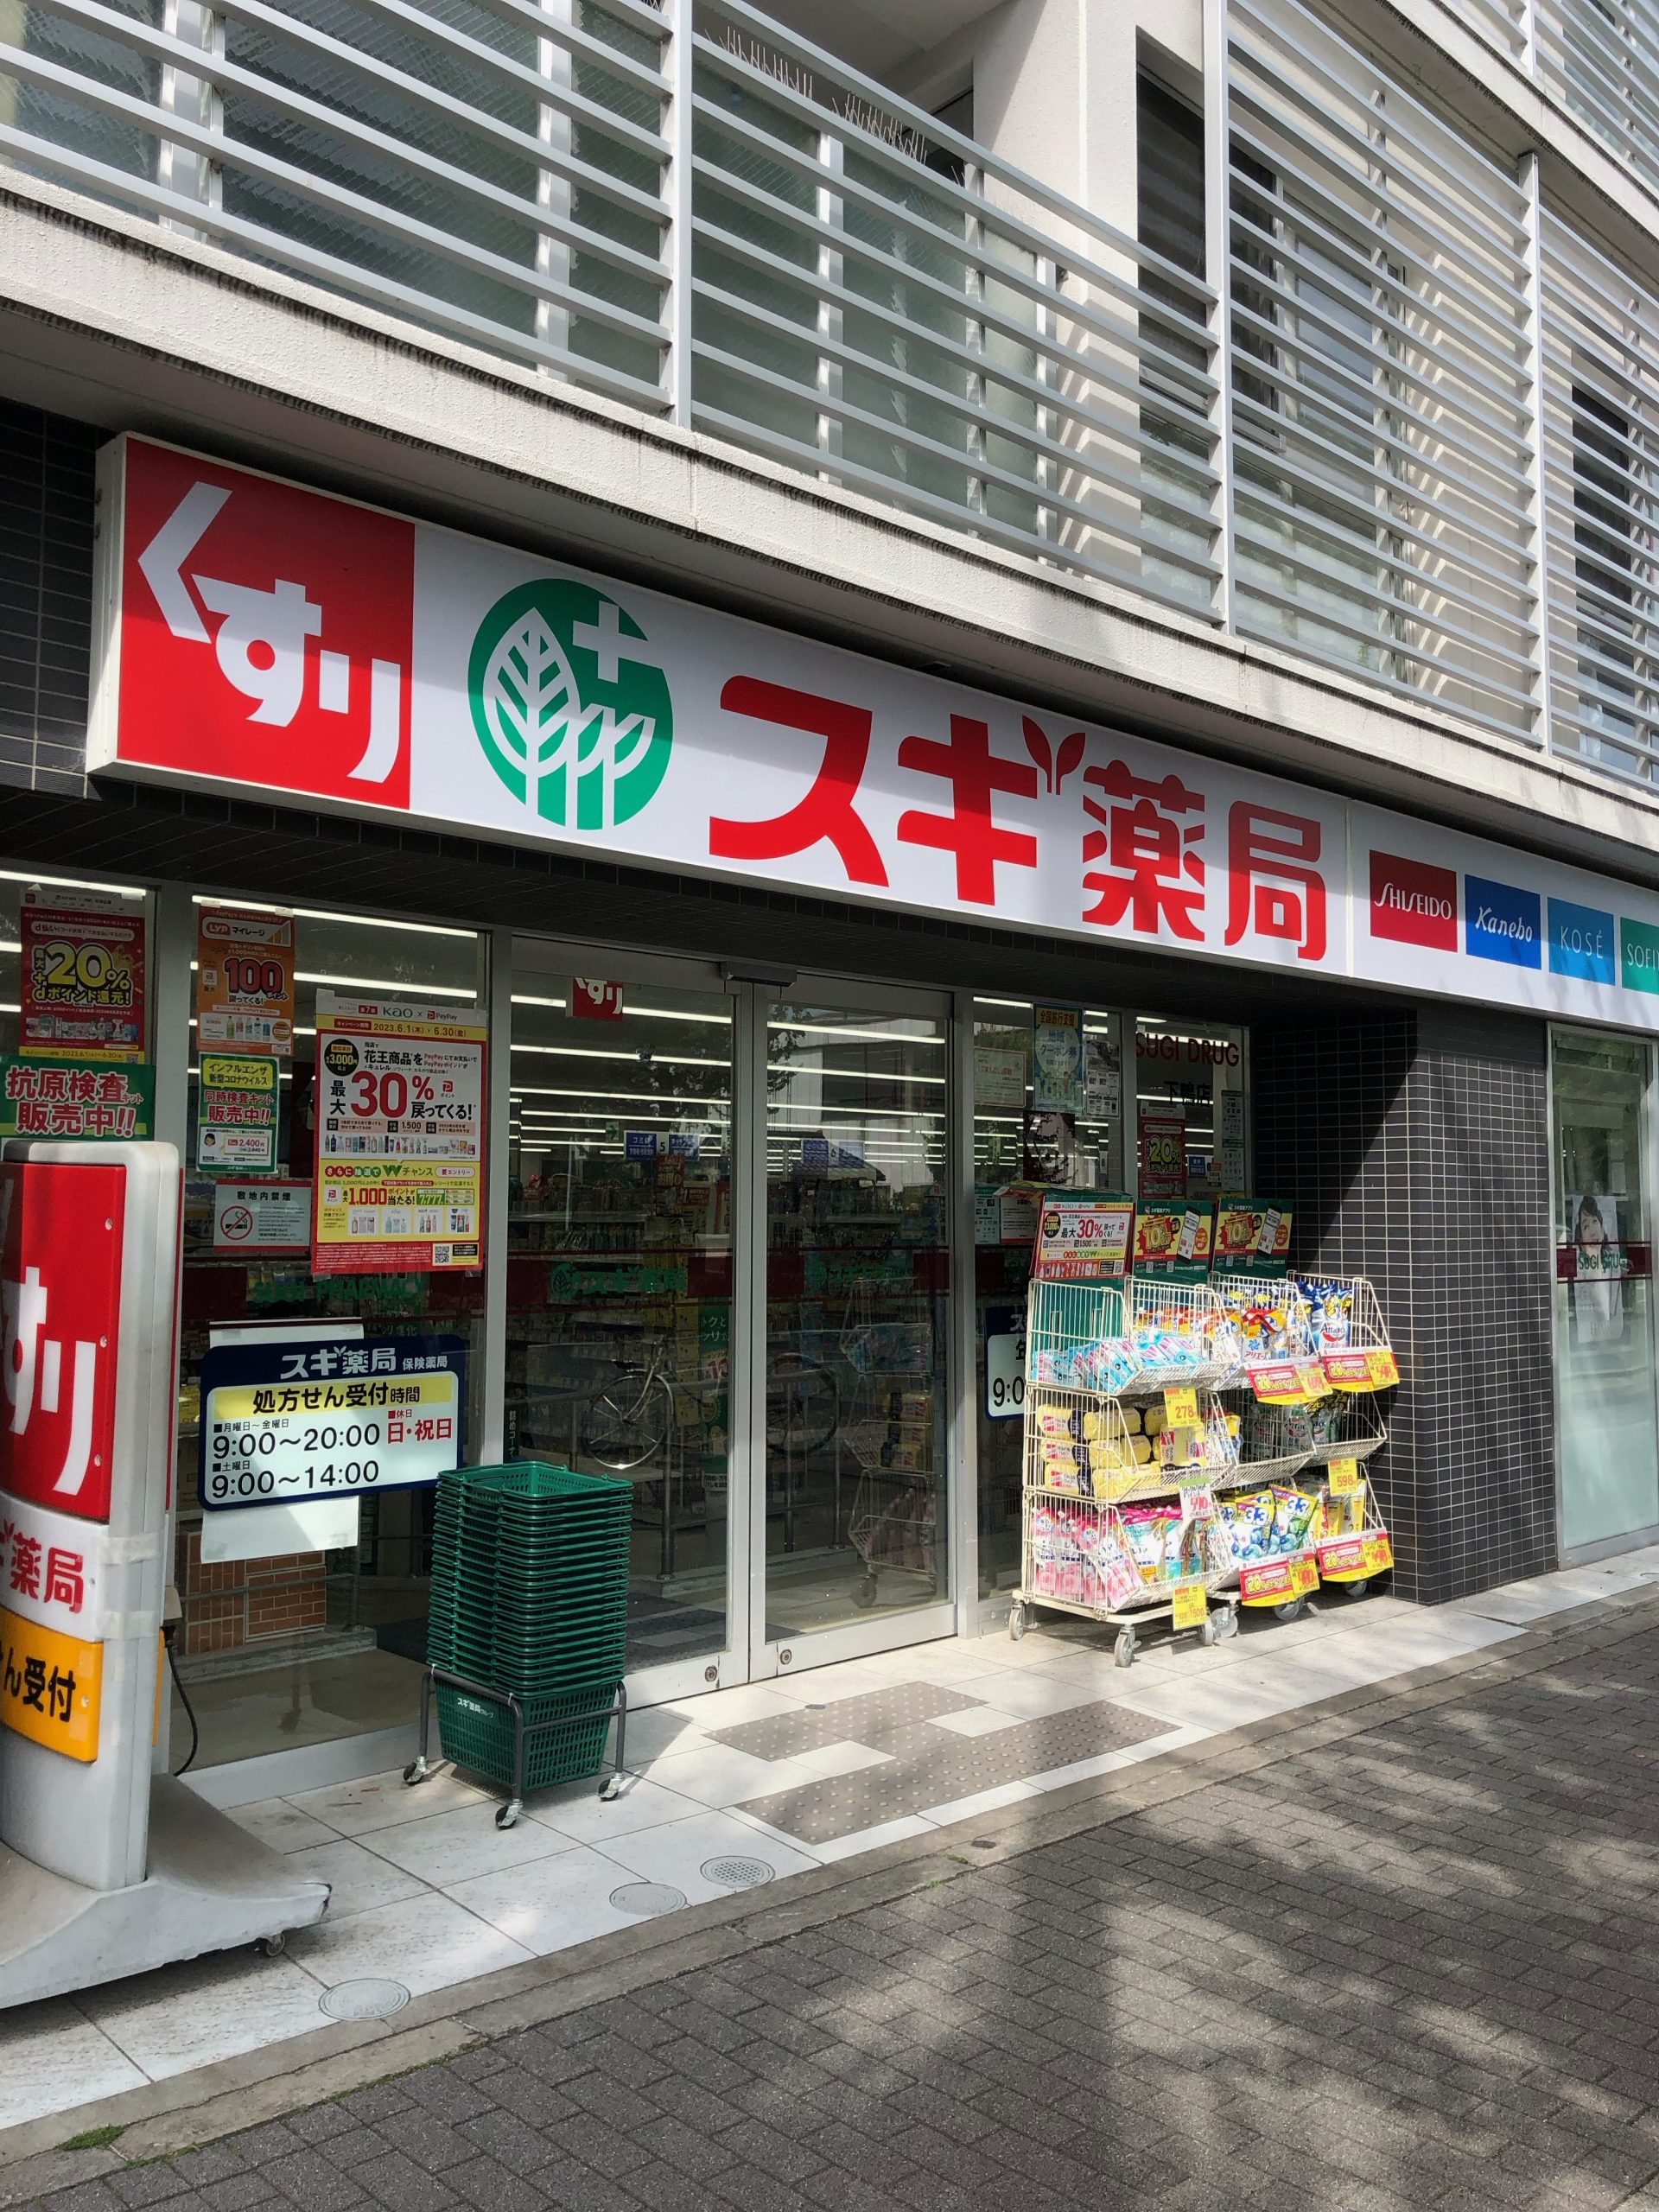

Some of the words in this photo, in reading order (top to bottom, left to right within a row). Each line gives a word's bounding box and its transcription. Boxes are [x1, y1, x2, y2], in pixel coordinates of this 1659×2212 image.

[137, 480, 401, 784] くすり
[709, 674, 1327, 961] スギ薬局
[1374, 882, 1452, 920] SHISEIDO
[232, 926, 265, 936] マイレージ
[1474, 906, 1533, 943] Kanebo
[1560, 925, 1604, 959] KOSÉ
[1626, 943, 1659, 977] SOFI
[223, 957, 283, 995] 100
[1039, 1044, 1077, 1058] クーポン券
[1135, 1033, 1179, 1061] SUGI
[1188, 1039, 1240, 1067] DRUG
[209, 1063, 268, 1076] インフルエンザ
[209, 1073, 268, 1085] 新型コロナウイルス
[204, 1090, 275, 1105] 同時検査キット
[350, 1070, 434, 1117] 30%
[17, 1102, 136, 1137] 販売中!!
[208, 1105, 270, 1126] 販売中!!
[659, 1141, 665, 1152] 5
[237, 1191, 291, 1201] 敷地内禁煙
[349, 1187, 387, 1205] 1,000
[1077, 1219, 1103, 1239] 30%
[280, 1346, 396, 1380] スギ薬局
[403, 1356, 448, 1371] 保険薬局
[252, 1382, 421, 1414] 処方せん受付時間
[397, 1409, 413, 1420] 休日
[387, 1418, 453, 1445] 日・祝日
[222, 1460, 251, 1472] 土曜日
